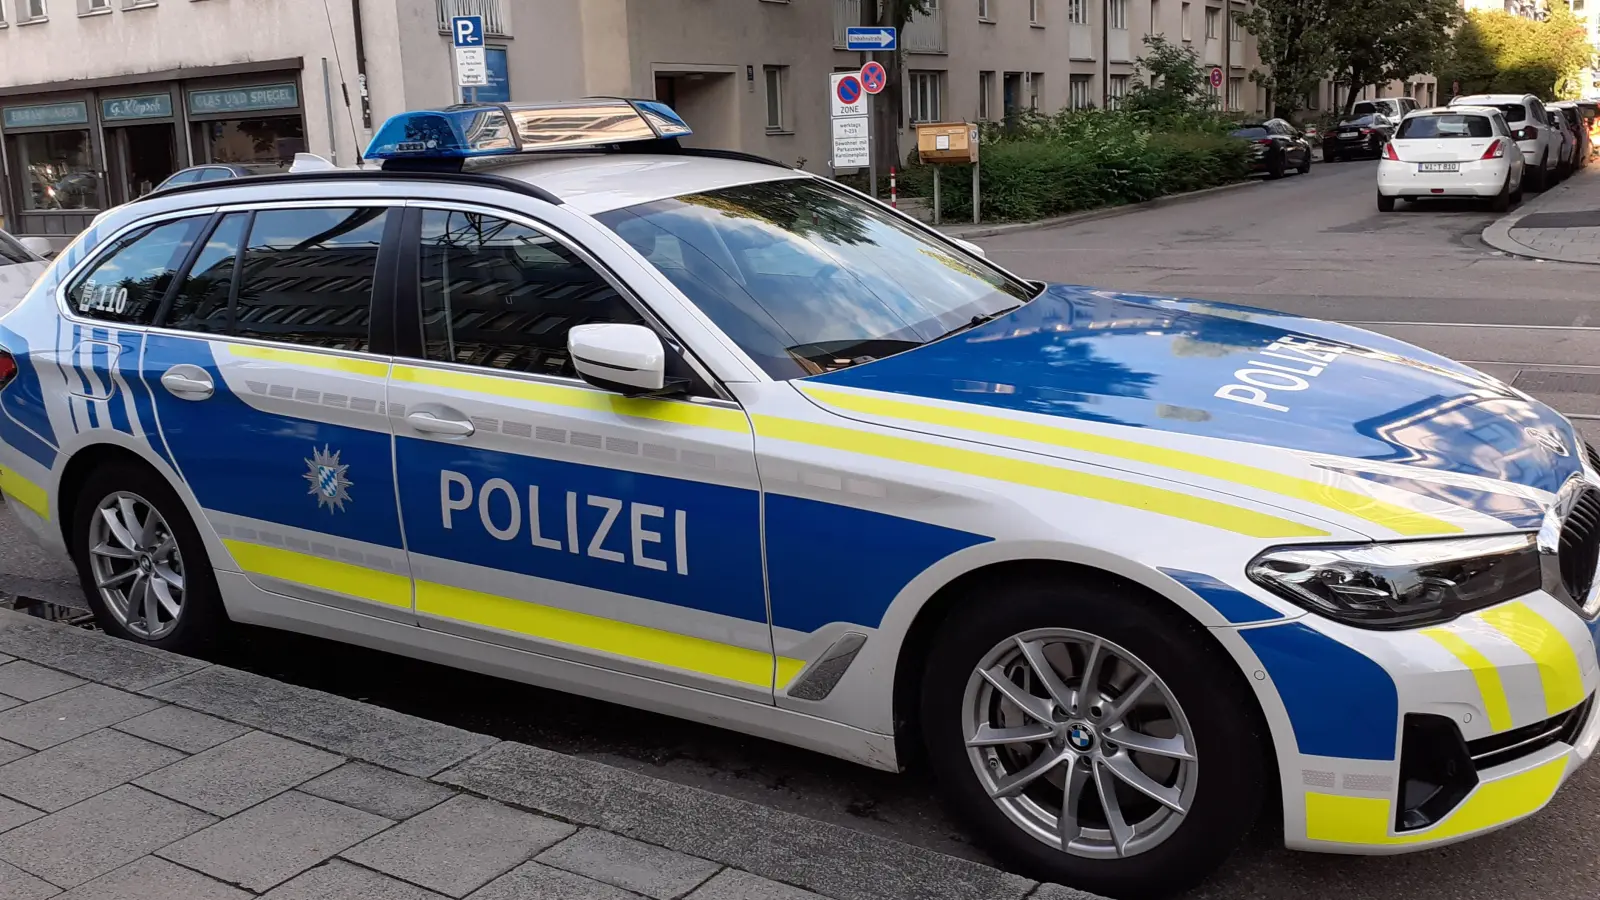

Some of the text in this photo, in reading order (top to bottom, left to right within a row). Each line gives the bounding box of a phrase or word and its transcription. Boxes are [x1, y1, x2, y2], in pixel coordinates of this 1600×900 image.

[457, 20, 473, 44] P
[225, 92, 248, 105] UND
[250, 88, 292, 103] SPIEGEL
[840, 105, 860, 114] ZONE
[96, 286, 128, 314] 110
[1213, 334, 1349, 413] POLIZEI
[440, 469, 689, 576] POLIZEI
